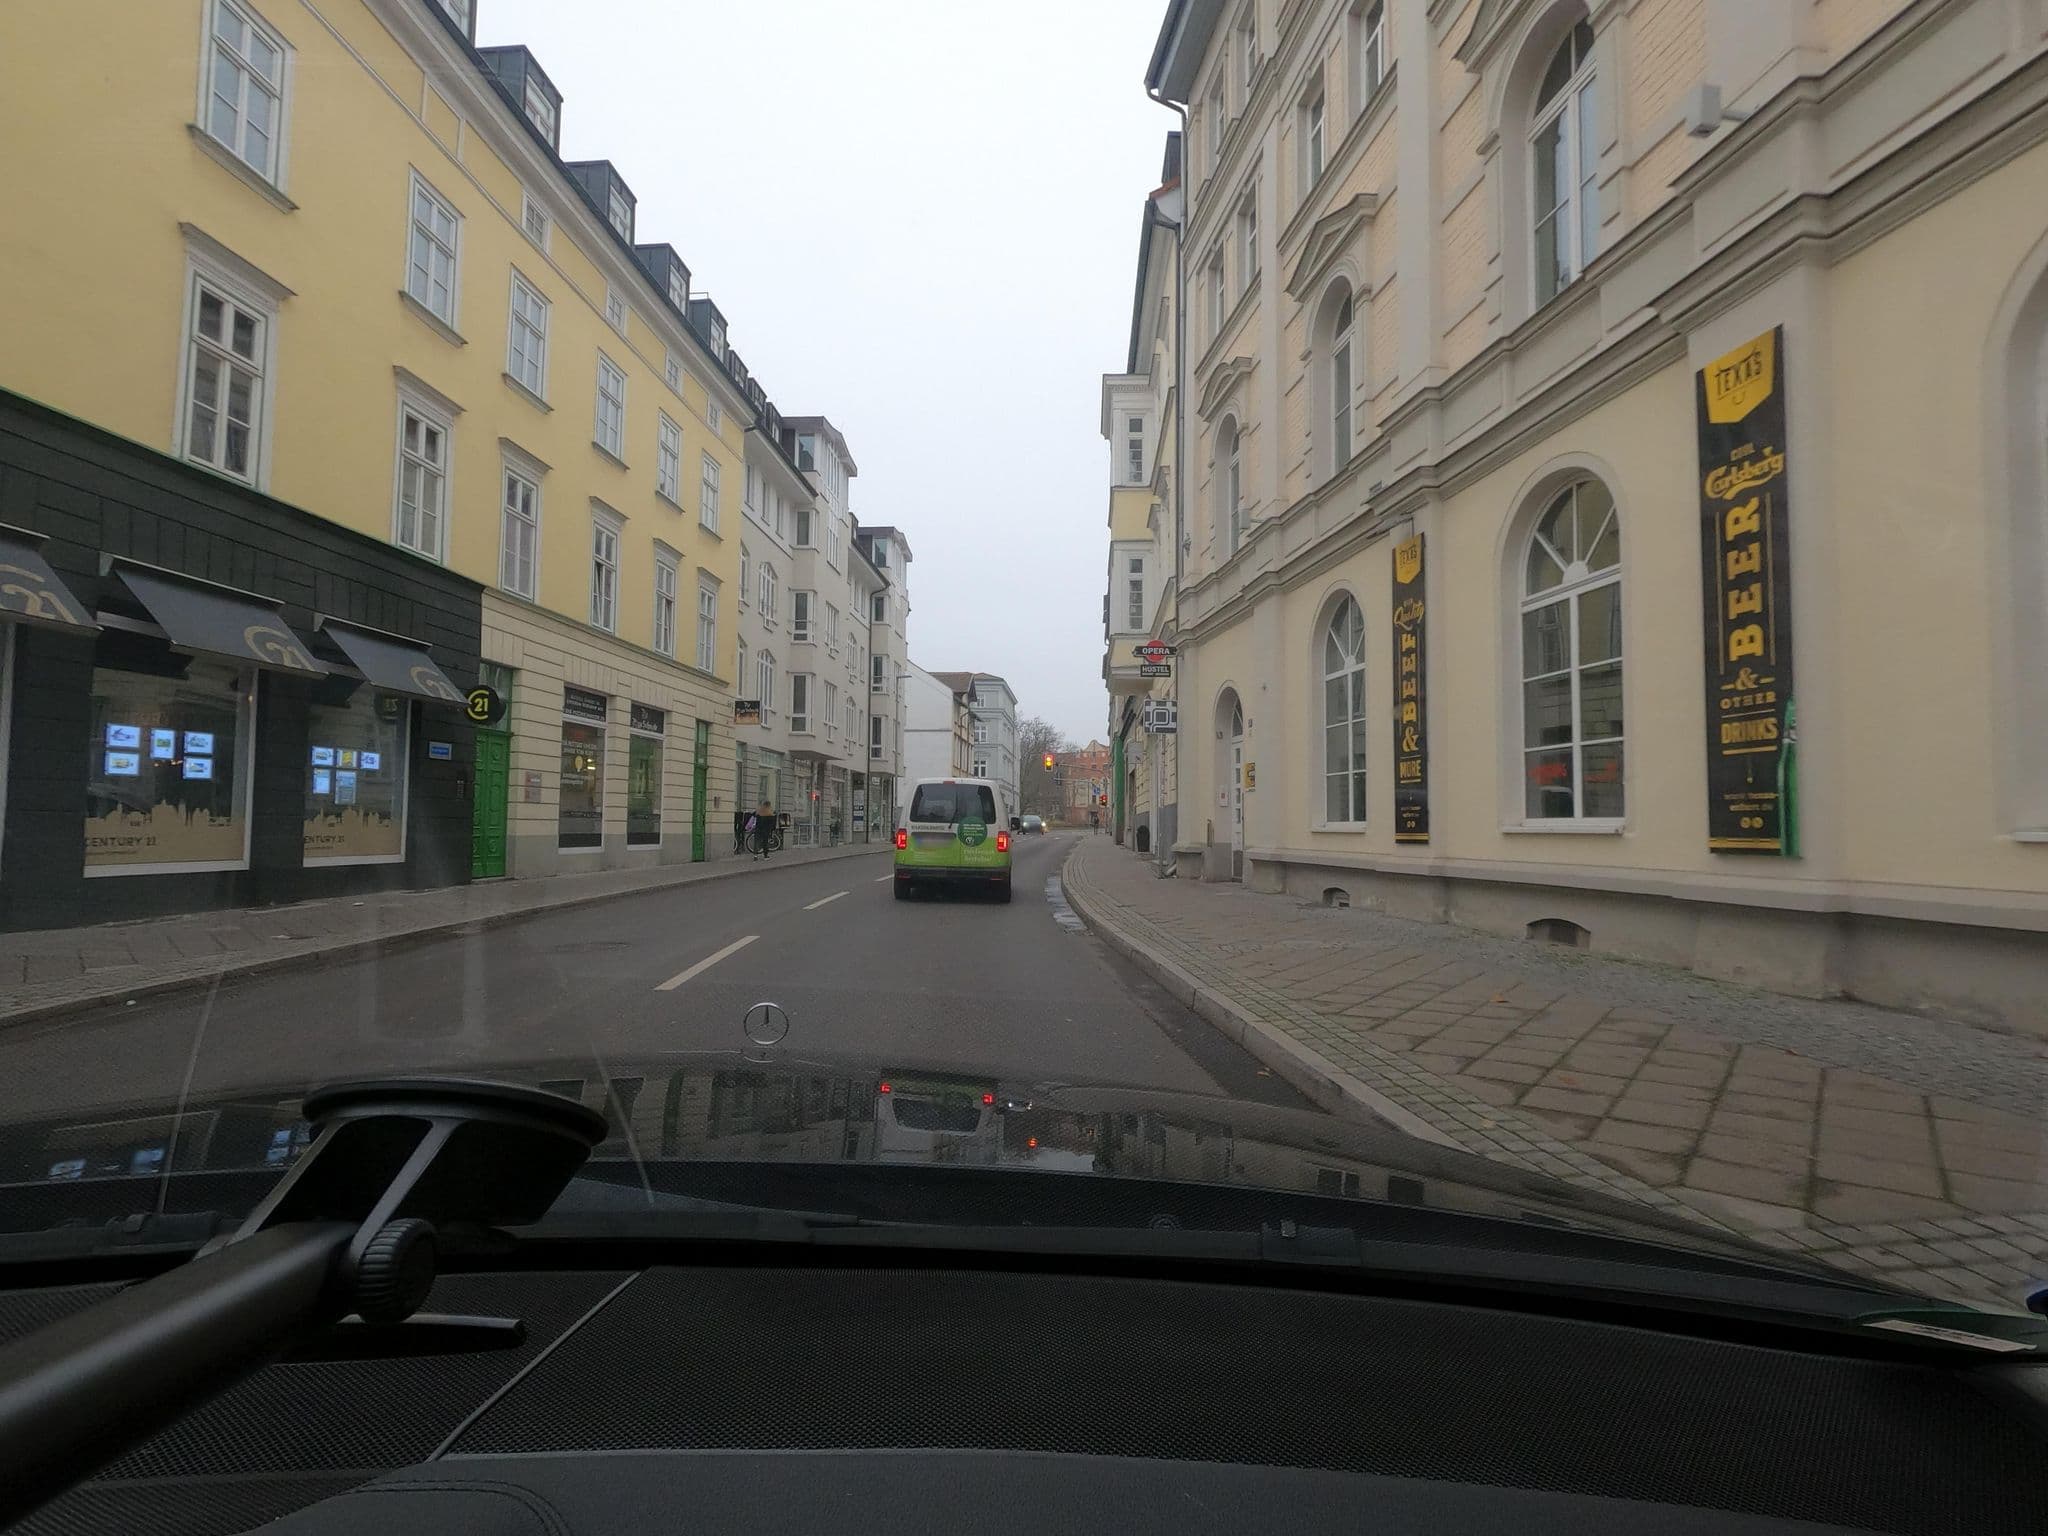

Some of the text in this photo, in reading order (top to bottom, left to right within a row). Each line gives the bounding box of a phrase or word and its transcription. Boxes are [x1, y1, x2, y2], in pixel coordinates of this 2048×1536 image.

[1713, 350, 1762, 397] TEXAS
[1705, 450, 1785, 500] Carlsberg
[1724, 497, 1764, 662] BEER
[1142, 647, 1170, 655] OPERA
[1142, 665, 1170, 673] HOSTEL
[1736, 667, 1759, 691] &
[1720, 691, 1777, 710] OTHER
[1402, 726, 1419, 752] &
[1721, 718, 1778, 744] DRINKS
[1400, 760, 1422, 779] MORE
[303, 835, 336, 844] ENTURY
